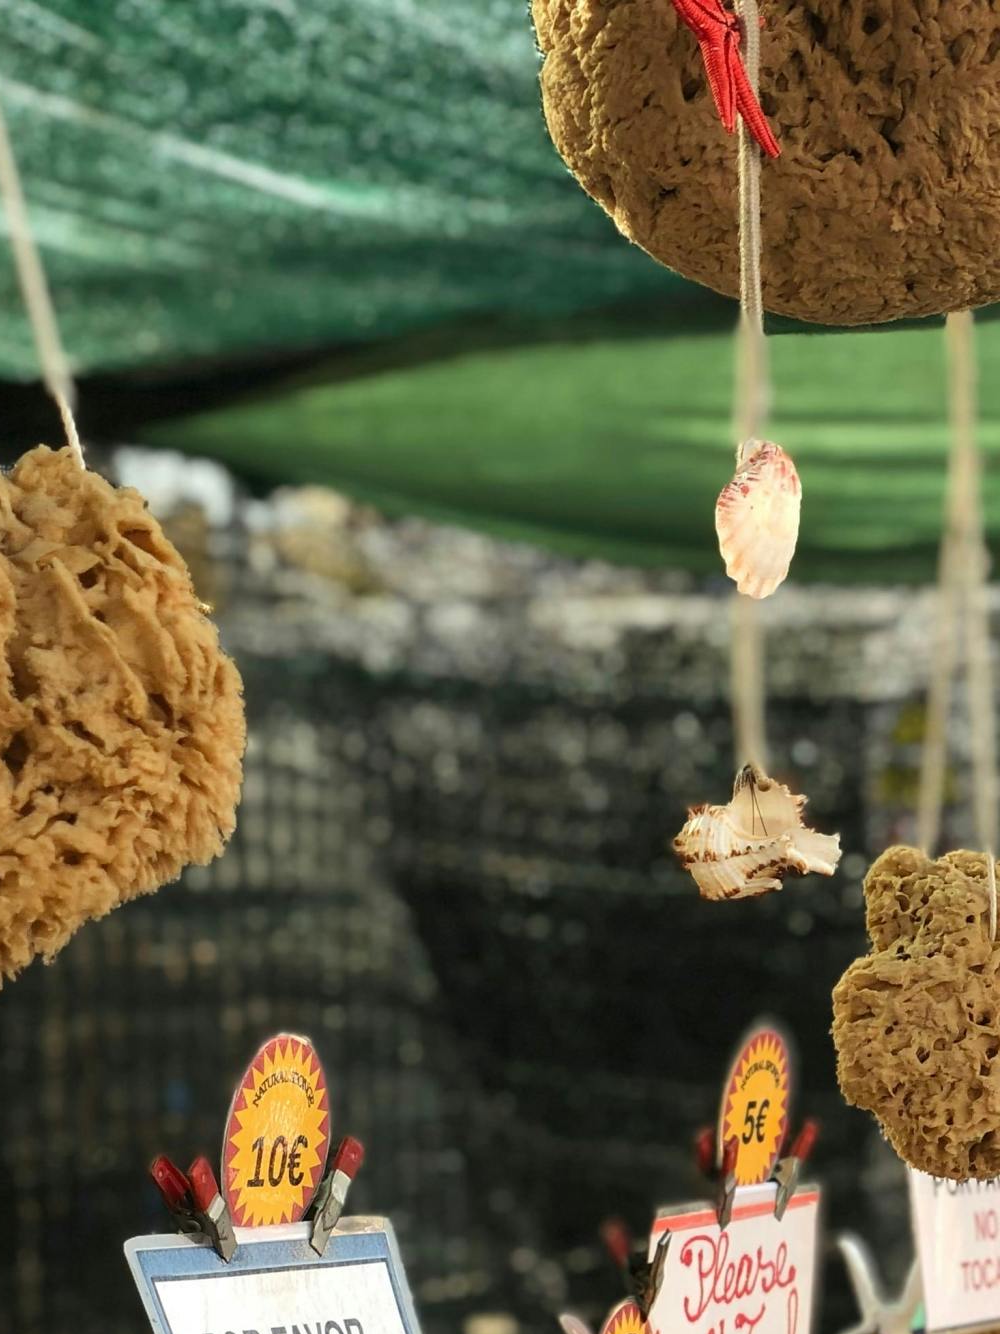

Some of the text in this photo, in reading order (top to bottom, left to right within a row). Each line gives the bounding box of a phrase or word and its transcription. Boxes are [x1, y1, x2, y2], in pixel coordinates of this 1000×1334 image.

[289, 1071, 315, 1108] PONGE
[742, 1099, 770, 1145] 5€
[246, 1135, 309, 1188] 10€
[973, 1208, 998, 1241] NO
[680, 1231, 797, 1323] Please
